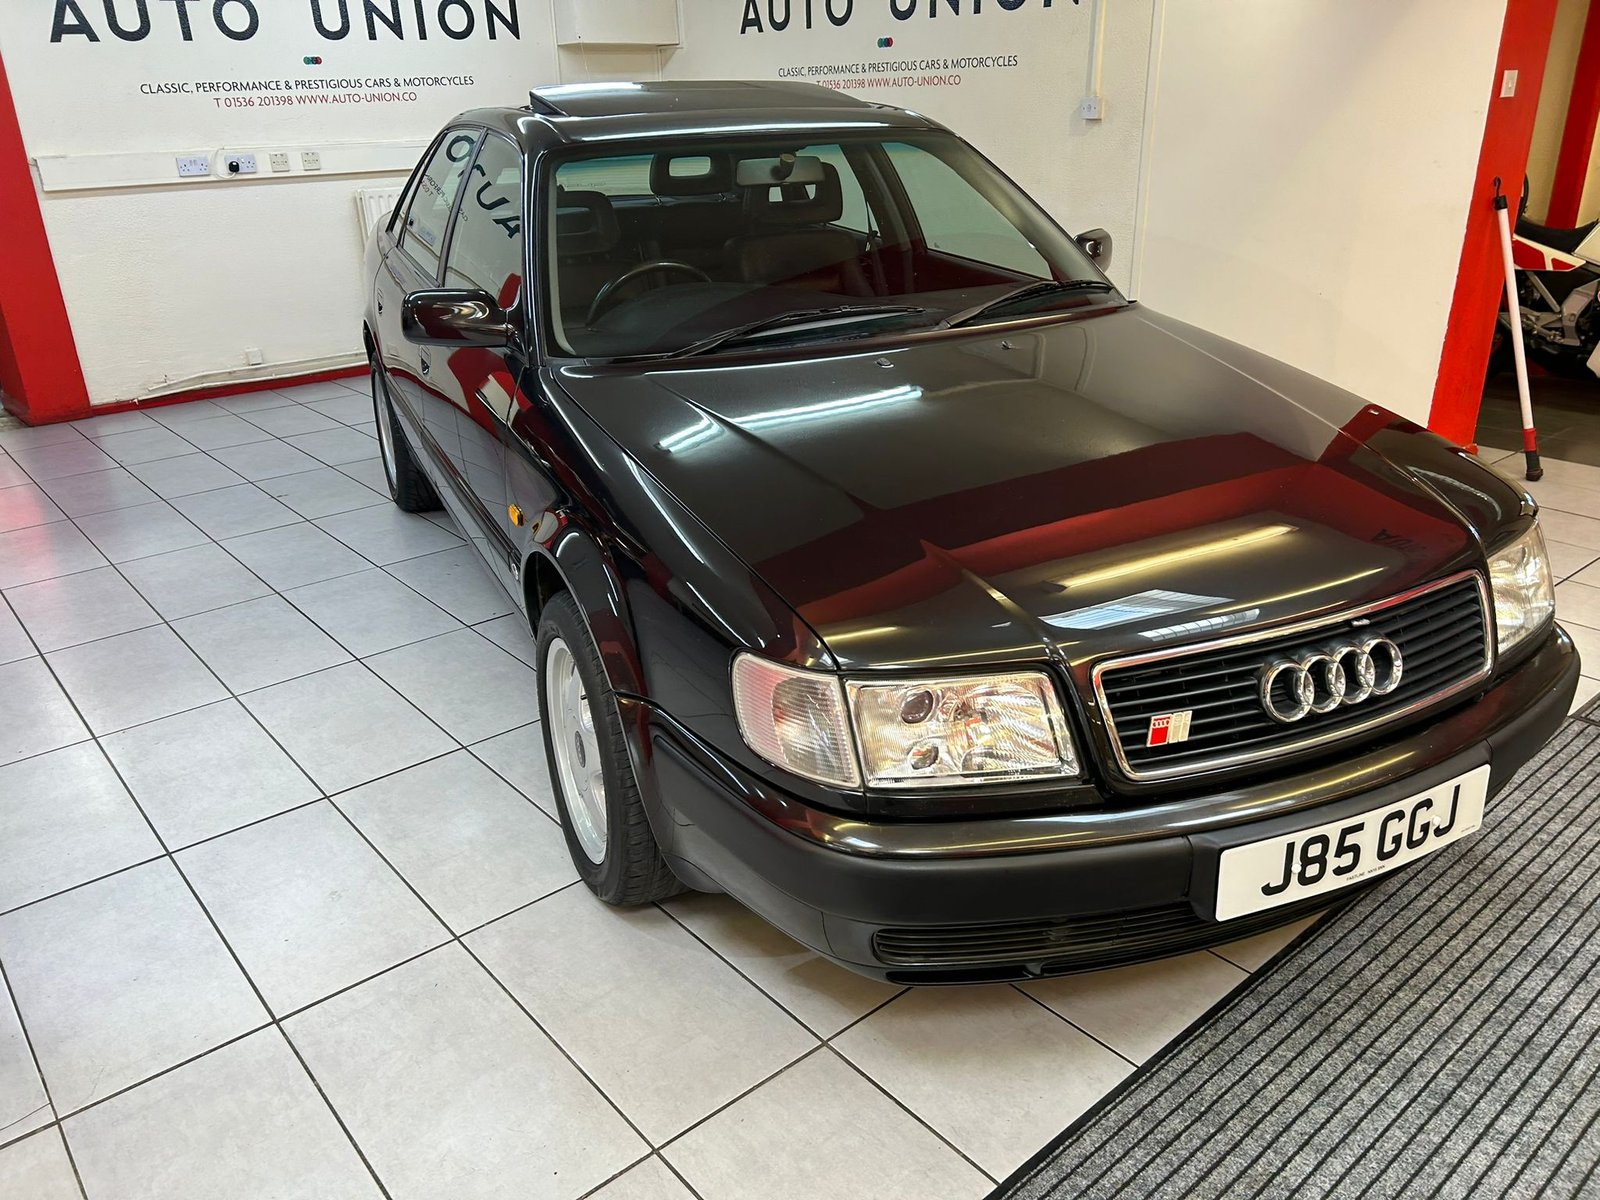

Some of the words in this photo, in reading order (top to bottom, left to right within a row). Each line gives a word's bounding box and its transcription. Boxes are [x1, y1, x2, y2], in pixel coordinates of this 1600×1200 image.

[50, 0, 260, 42] AUTO
[310, 0, 521, 41] UNION
[778, 66, 806, 77] CLASSIC,
[807, 63, 860, 76] PERFORMANCE
[861, 63, 867, 73] &
[868, 60, 918, 73] PRESTIGIOUS
[919, 59, 941, 70] CARS
[942, 58, 949, 69] &
[951, 55, 1018, 69] MOTORCYCLES
[140, 83, 194, 95] CLASSIC,
[195, 80, 282, 93] PERFORMANCE
[284, 80, 293, 90] &
[295, 78, 363, 90] PRESTIGIOUS
[365, 77, 392, 88] CARS
[393, 77, 401, 88] &
[403, 75, 475, 87] MOTORCYCLES
[822, 80, 841, 90] 01536
[842, 79, 866, 89] 201398
[867, 74, 961, 88] WWW.AUTO-UNION.CO
[214, 98, 221, 108] T
[224, 97, 255, 108] 01536
[258, 95, 294, 107] 201398
[295, 91, 418, 105] WWW.AUTO-UNION.CO
[1261, 822, 1365, 897] J85
[1376, 784, 1461, 862] GGJ
